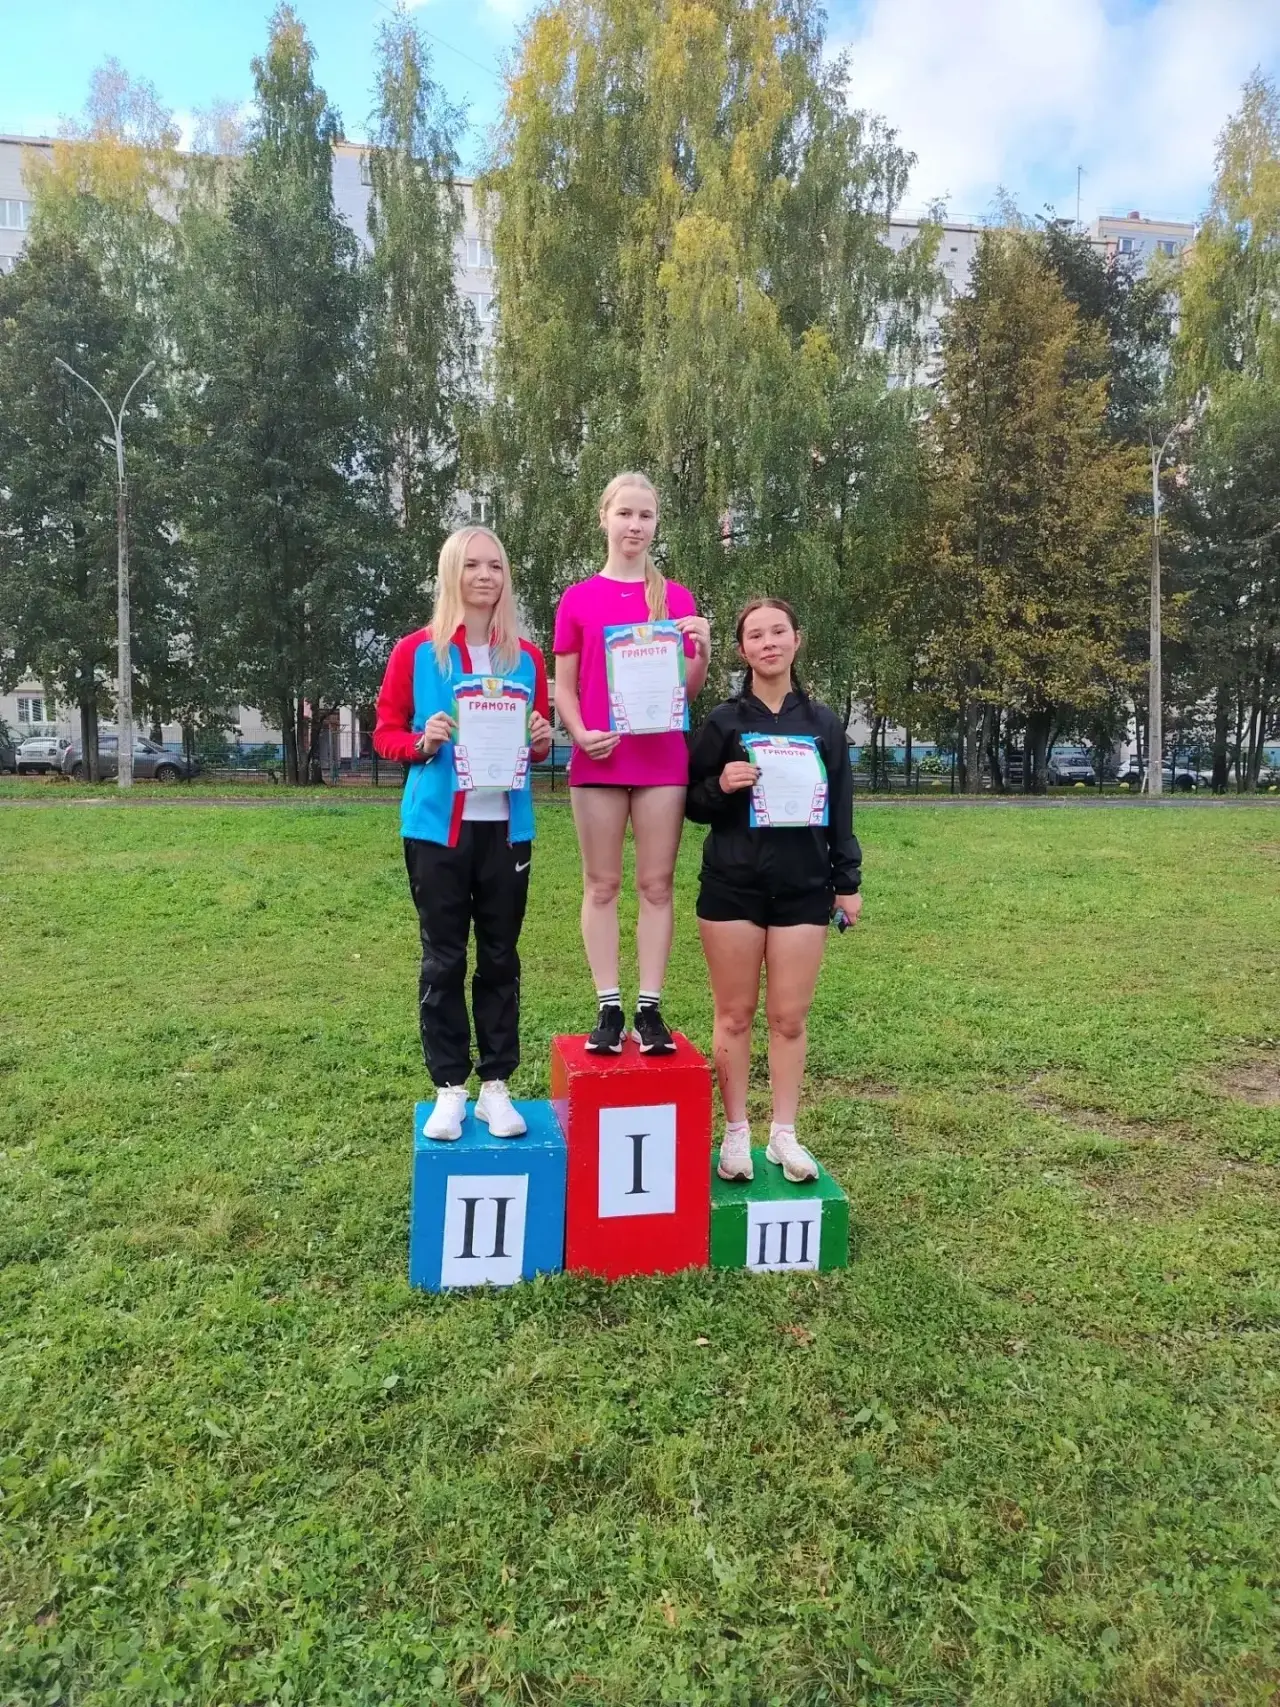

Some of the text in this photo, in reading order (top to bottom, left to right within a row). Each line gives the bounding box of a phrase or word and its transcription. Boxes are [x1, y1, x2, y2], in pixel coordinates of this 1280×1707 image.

[622, 646, 668, 659] ГРАМОТА
[469, 701, 516, 711] ГРАМОТА
[624, 1133, 651, 1195] I
[453, 1197, 516, 1258] II
[753, 1219, 814, 1265] III
